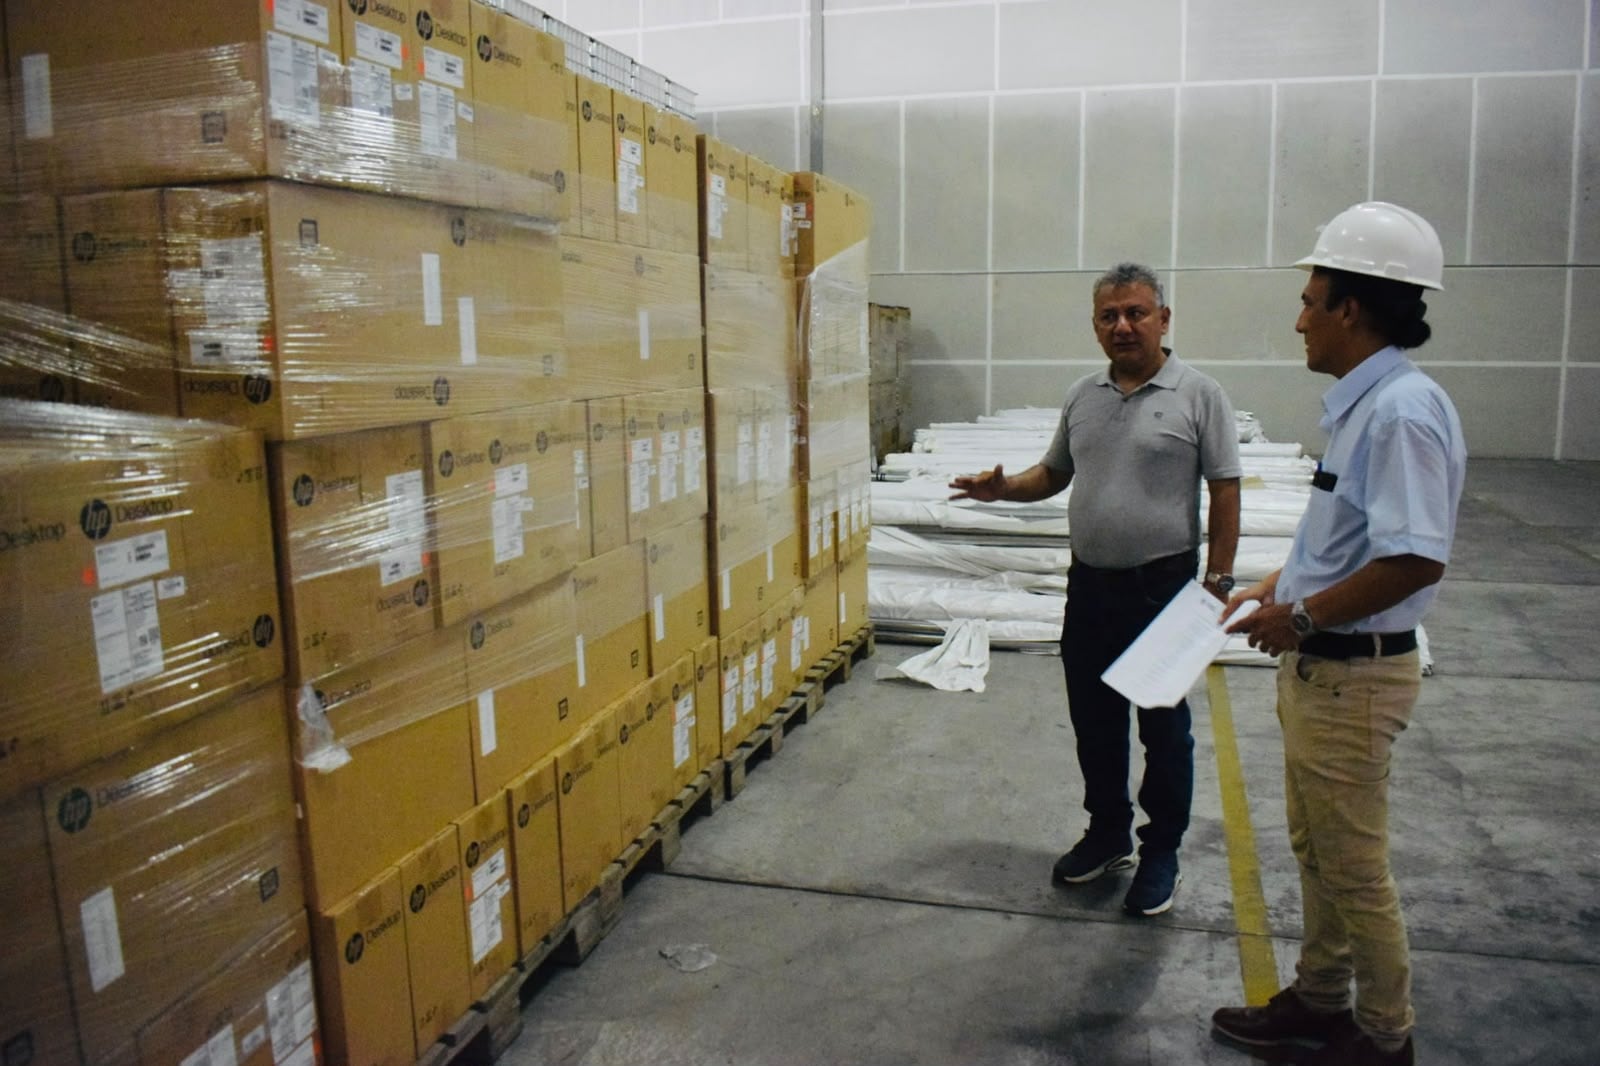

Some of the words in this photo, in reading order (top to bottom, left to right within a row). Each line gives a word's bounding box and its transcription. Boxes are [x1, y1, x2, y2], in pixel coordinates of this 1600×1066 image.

[435, 23, 467, 47] Desktop
[80, 498, 112, 541] hp
[115, 500, 174, 523] Desktop
[366, 910, 402, 945] Desktop
